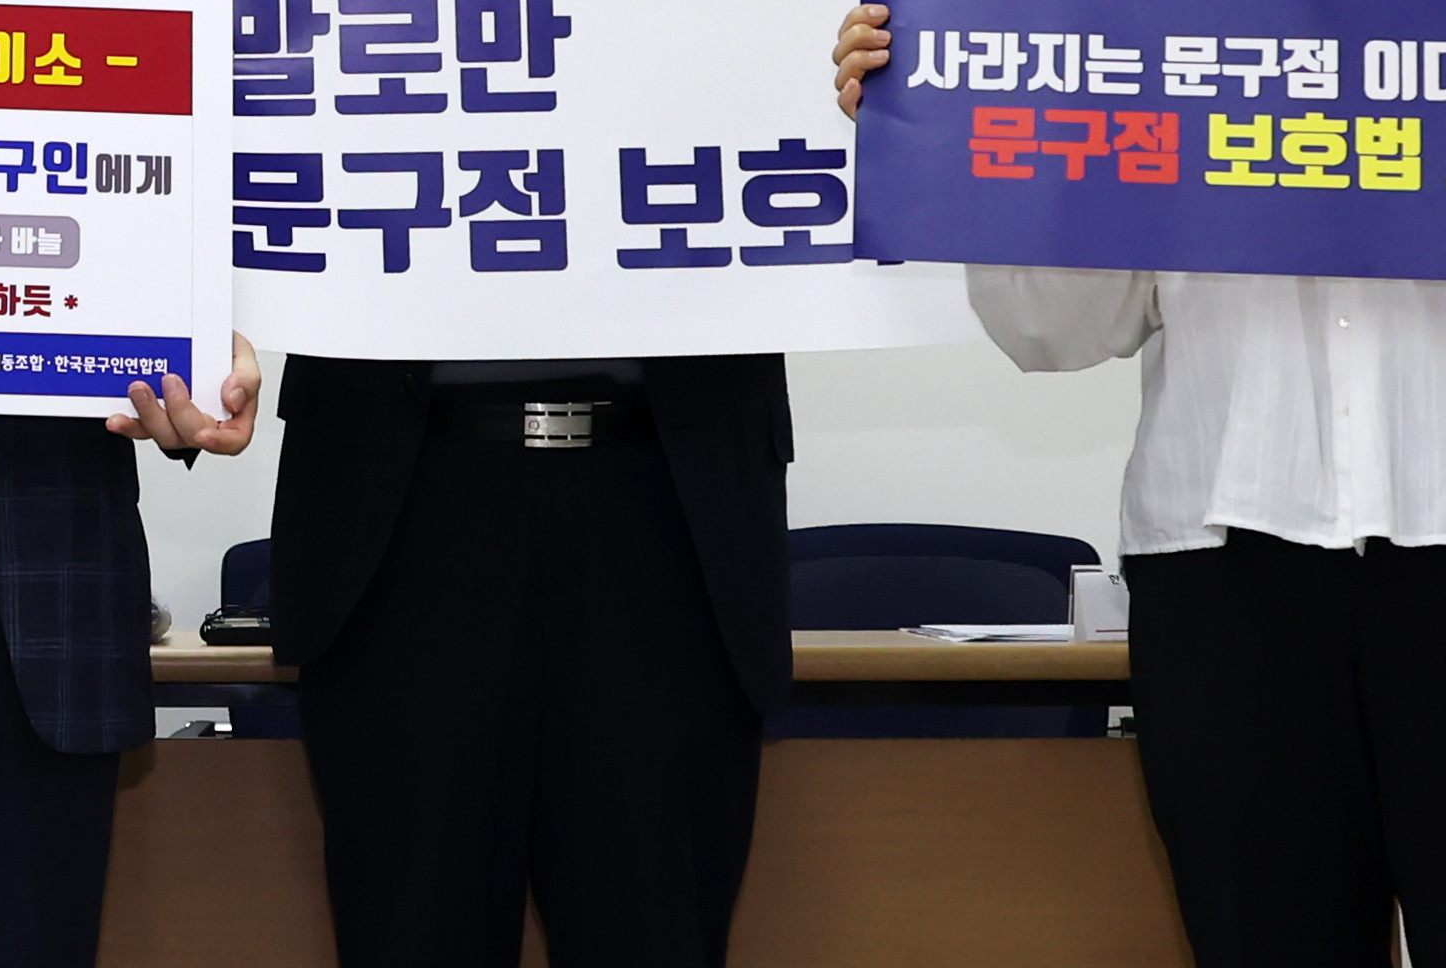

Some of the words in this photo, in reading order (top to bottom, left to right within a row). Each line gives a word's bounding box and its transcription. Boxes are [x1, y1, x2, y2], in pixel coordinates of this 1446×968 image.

[907, 30, 1144, 95] 사라지는
[1161, 35, 1339, 100] 문구점
[969, 106, 1180, 184] 문구점
[1209, 114, 1421, 189] 보호법
[232, 148, 569, 274] 문구점
[616, 137, 853, 270] 보호
[11, 227, 62, 256] 바늘
[54, 355, 170, 378] 한국문구인연합회
